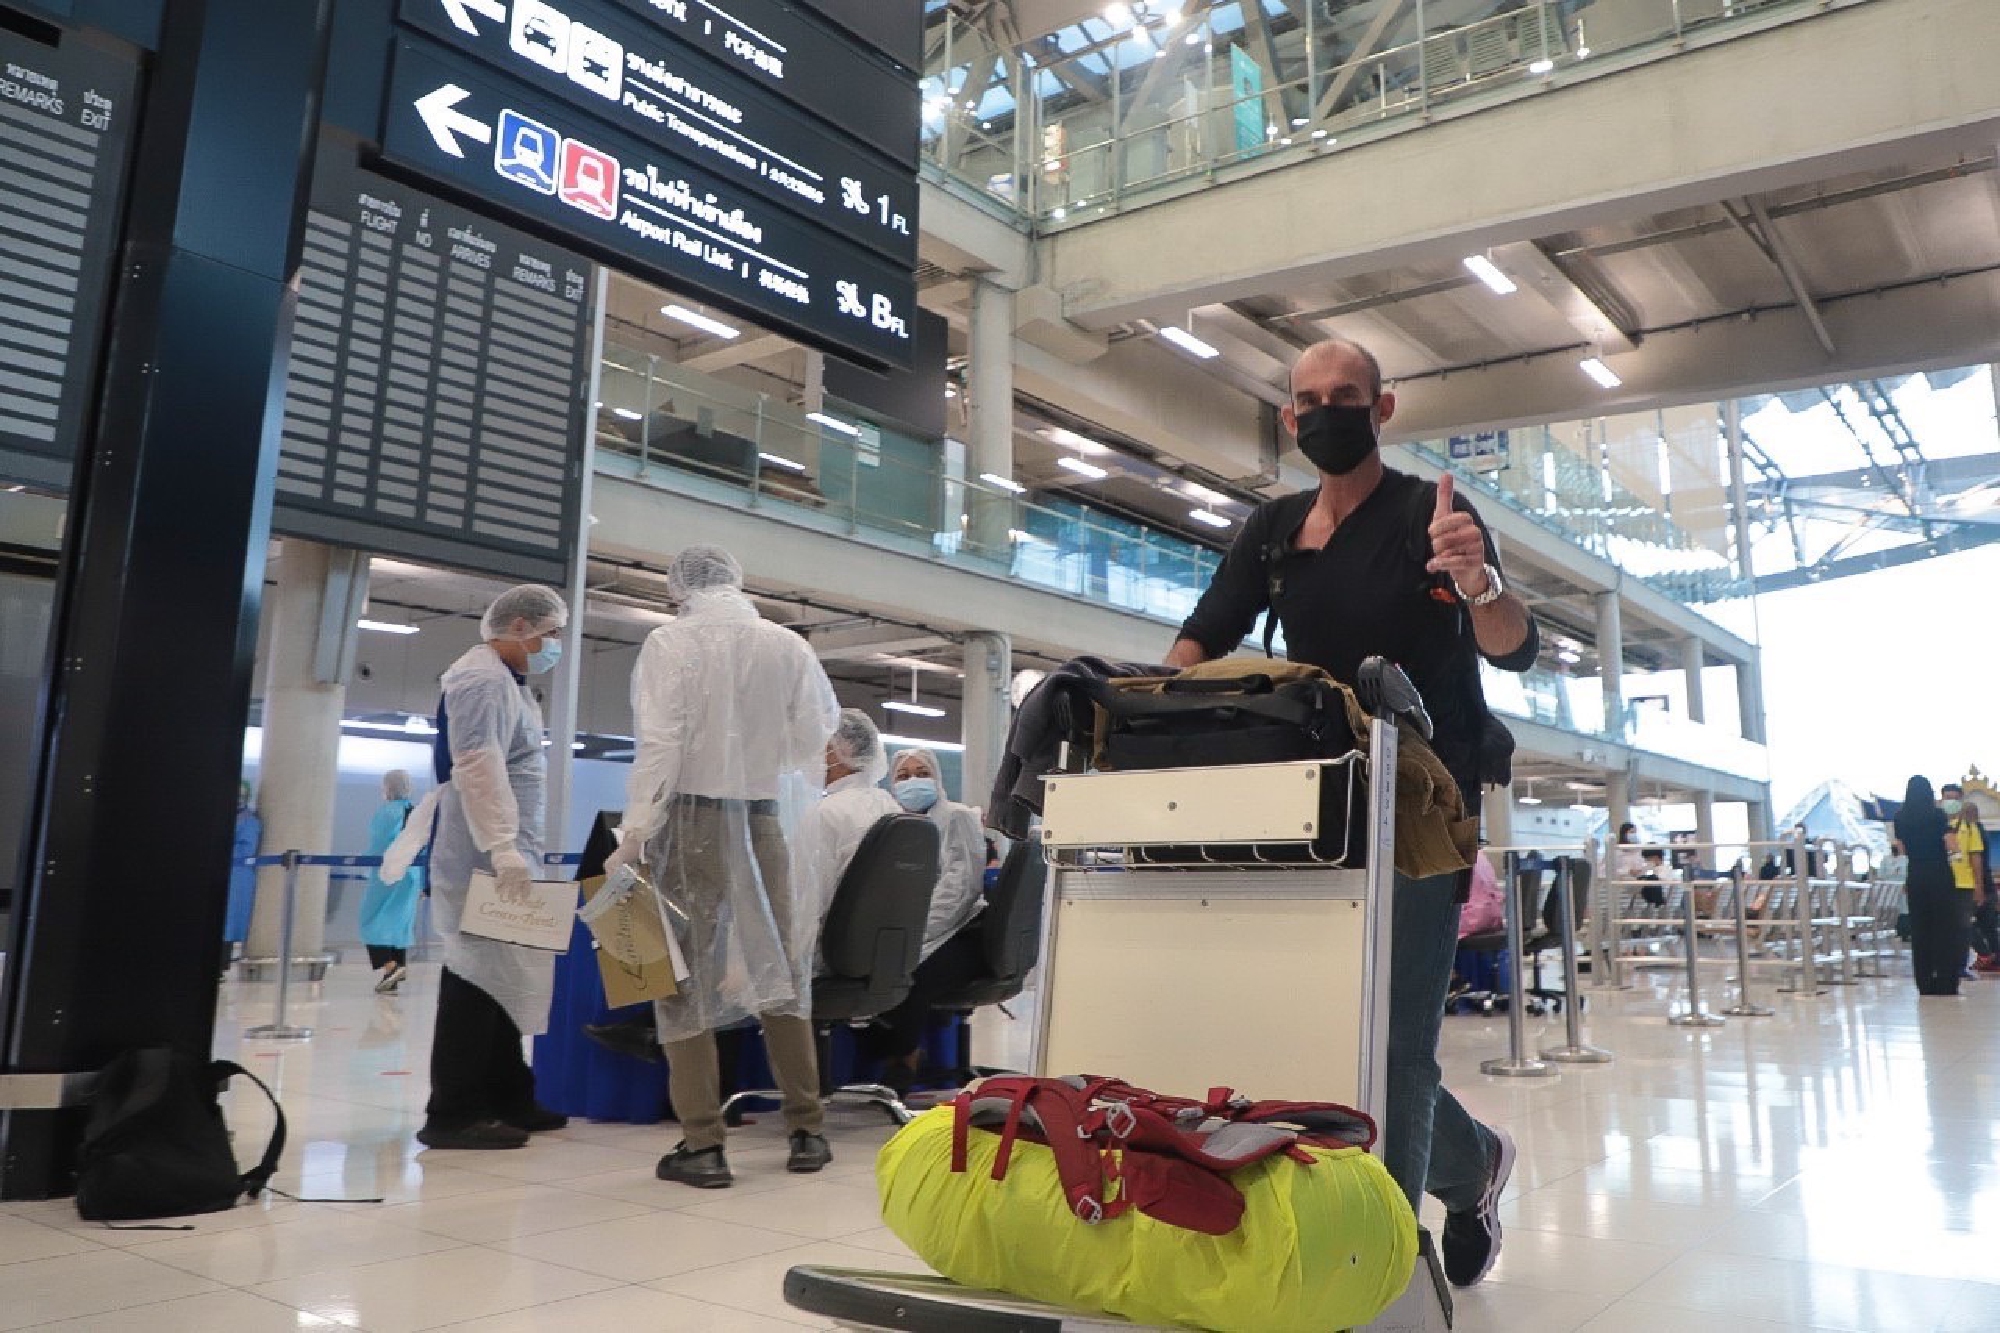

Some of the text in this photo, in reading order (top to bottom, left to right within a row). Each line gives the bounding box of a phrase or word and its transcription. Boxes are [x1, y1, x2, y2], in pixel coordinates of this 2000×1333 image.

[0, 77, 64, 115] REMARKS
[81, 108, 112, 131] EXIT
[623, 91, 757, 170] Public Transportation
[361, 210, 398, 234] FLIGHT
[416, 230, 433, 247] NO
[620, 210, 734, 270] Airport Rail Link
